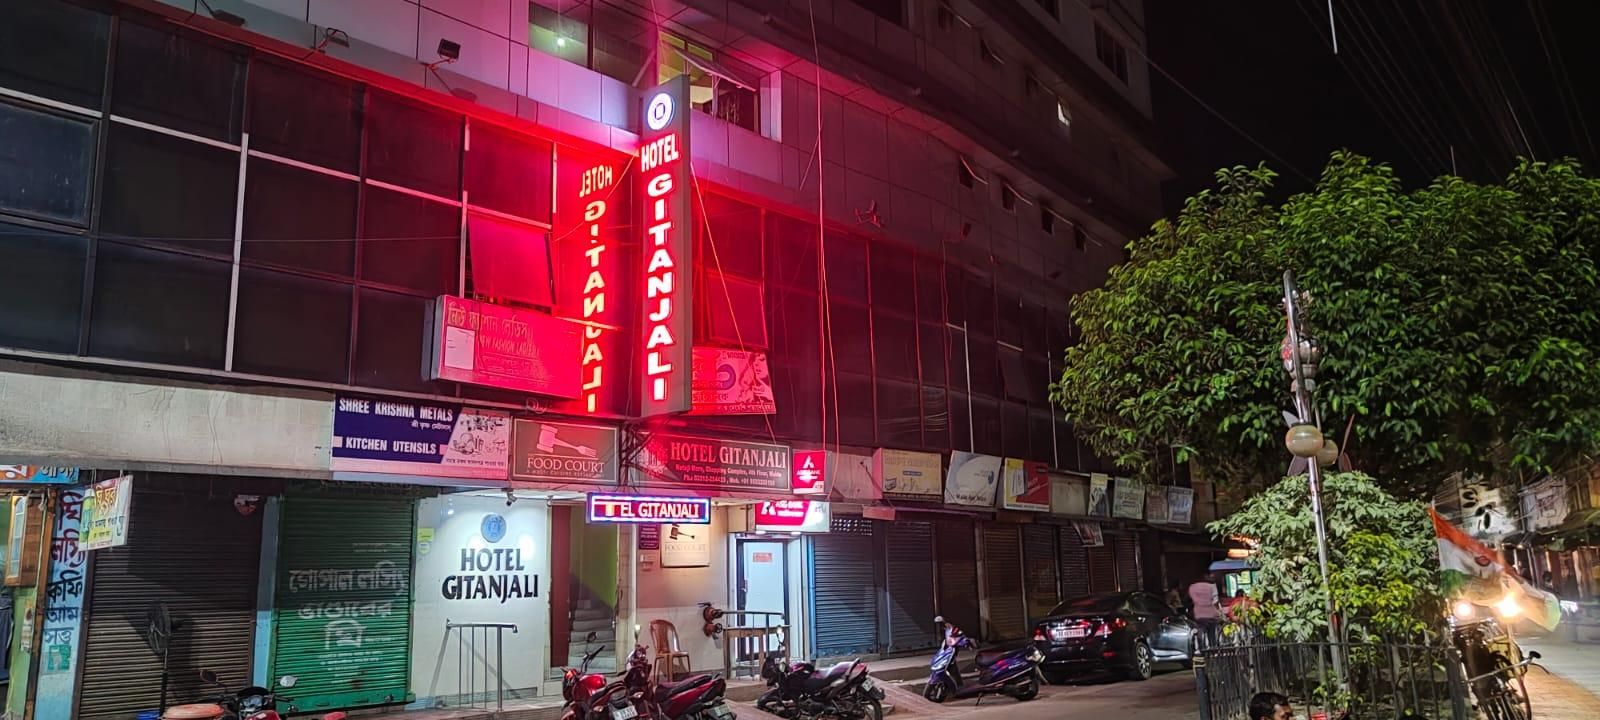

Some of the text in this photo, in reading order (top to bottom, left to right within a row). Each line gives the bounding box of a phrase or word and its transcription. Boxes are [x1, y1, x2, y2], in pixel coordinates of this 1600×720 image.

[641, 134, 679, 173] HOTEL
[646, 173, 674, 401] GITANJALI
[339, 397, 453, 422] SHREE KRISHNA METALS
[345, 436, 437, 455] KITCHEN UTENSILS
[671, 442, 786, 468] HOTEL GITANJALI
[527, 457, 605, 473] FOOD COURT
[638, 502, 700, 518] GITANJALI
[460, 548, 524, 572] HOTEL
[46, 569, 83, 603] কফি
[441, 574, 539, 604] GITANJALI
[45, 607, 80, 624] আম
